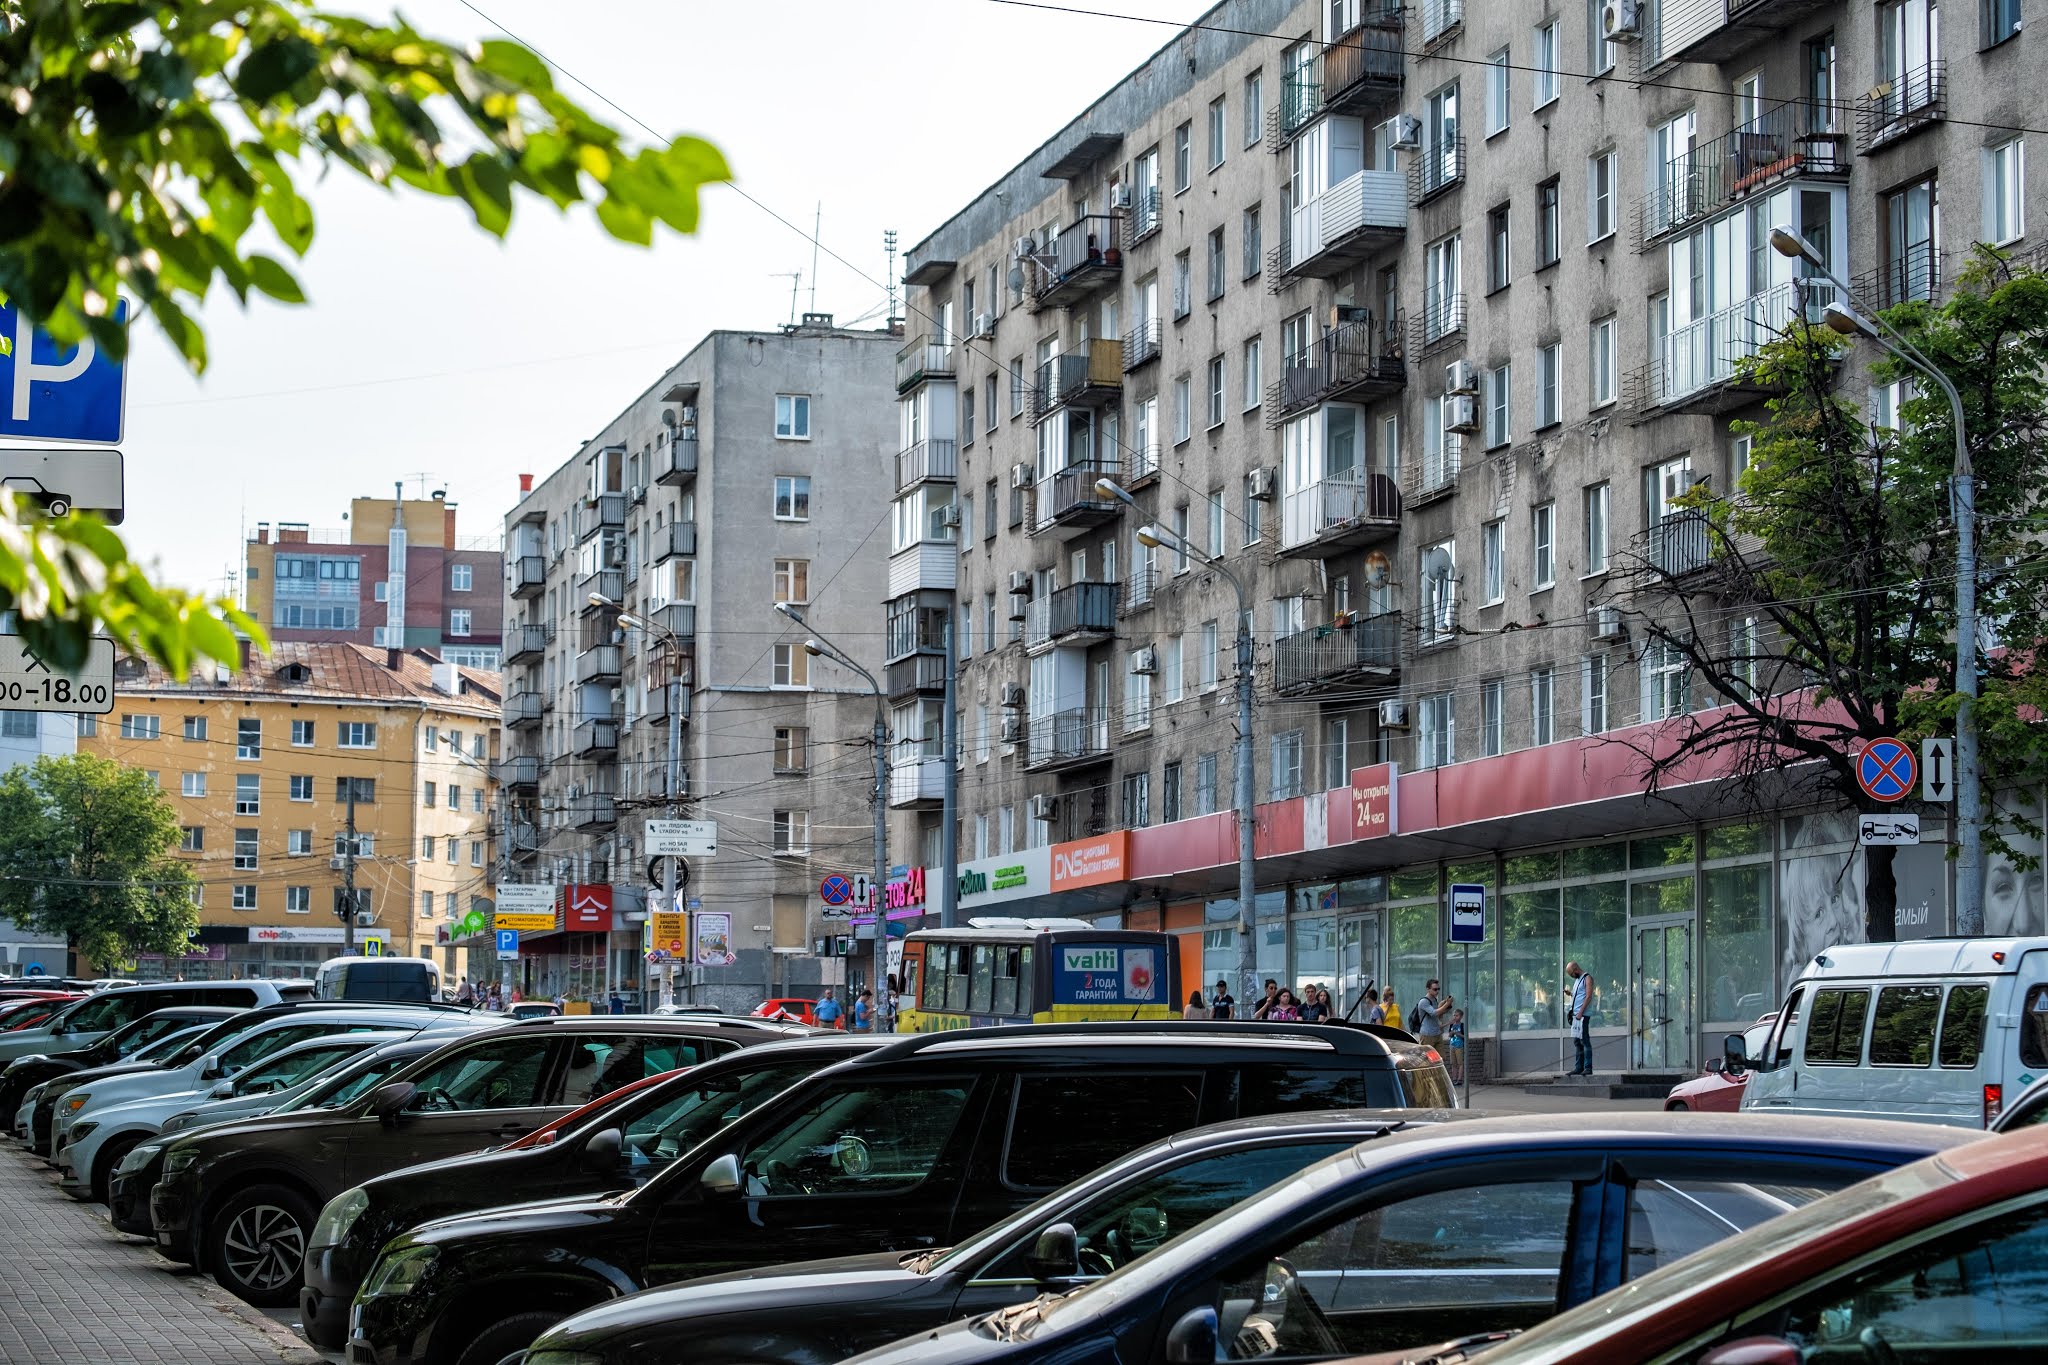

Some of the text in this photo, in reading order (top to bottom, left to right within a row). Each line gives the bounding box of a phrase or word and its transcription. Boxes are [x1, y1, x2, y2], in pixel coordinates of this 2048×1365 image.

[12, 305, 96, 421] P
[1353, 784, 1389, 801] Мы открыты
[1357, 801, 1385, 827] 24 часа
[1055, 849, 1083, 880] DNS
[907, 867, 923, 905] 24
[1895, 900, 1928, 926] амый
[501, 932, 512, 949] P
[1067, 950, 1115, 969] vatti
[1084, 972, 1117, 990] 2 ГОДА
[1075, 990, 1118, 1000] ГАРАНТИИ
